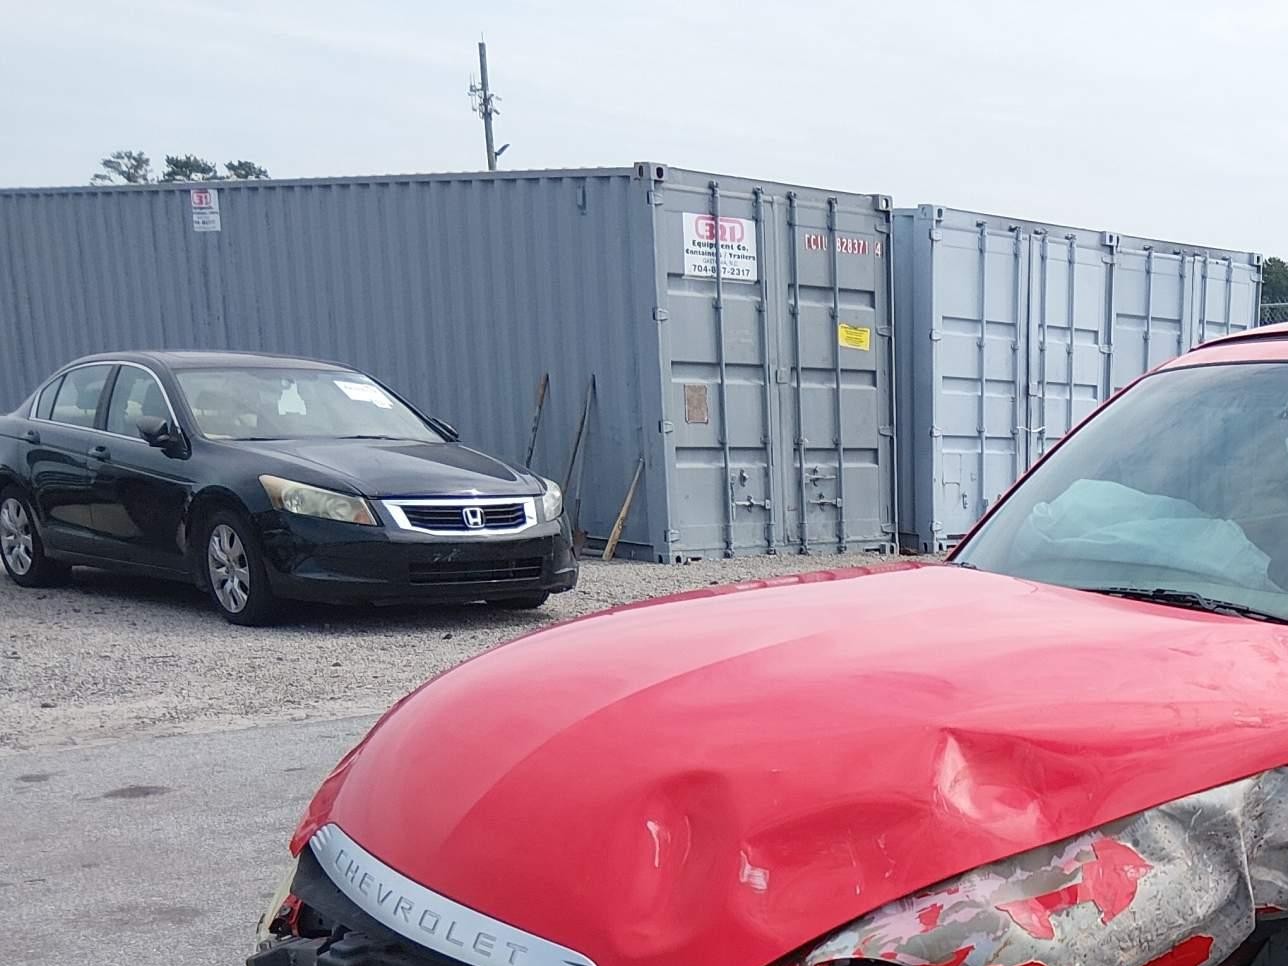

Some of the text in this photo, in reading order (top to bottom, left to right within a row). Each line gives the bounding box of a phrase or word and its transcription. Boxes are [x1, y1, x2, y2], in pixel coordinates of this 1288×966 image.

[692, 239, 734, 251] Equipent
[836, 237, 869, 255] 828371
[685, 247, 722, 258] Containes
[728, 252, 756, 261] Trailers
[691, 264, 751, 277] 704-87-2317
[335, 849, 530, 965] CHEVROLET
